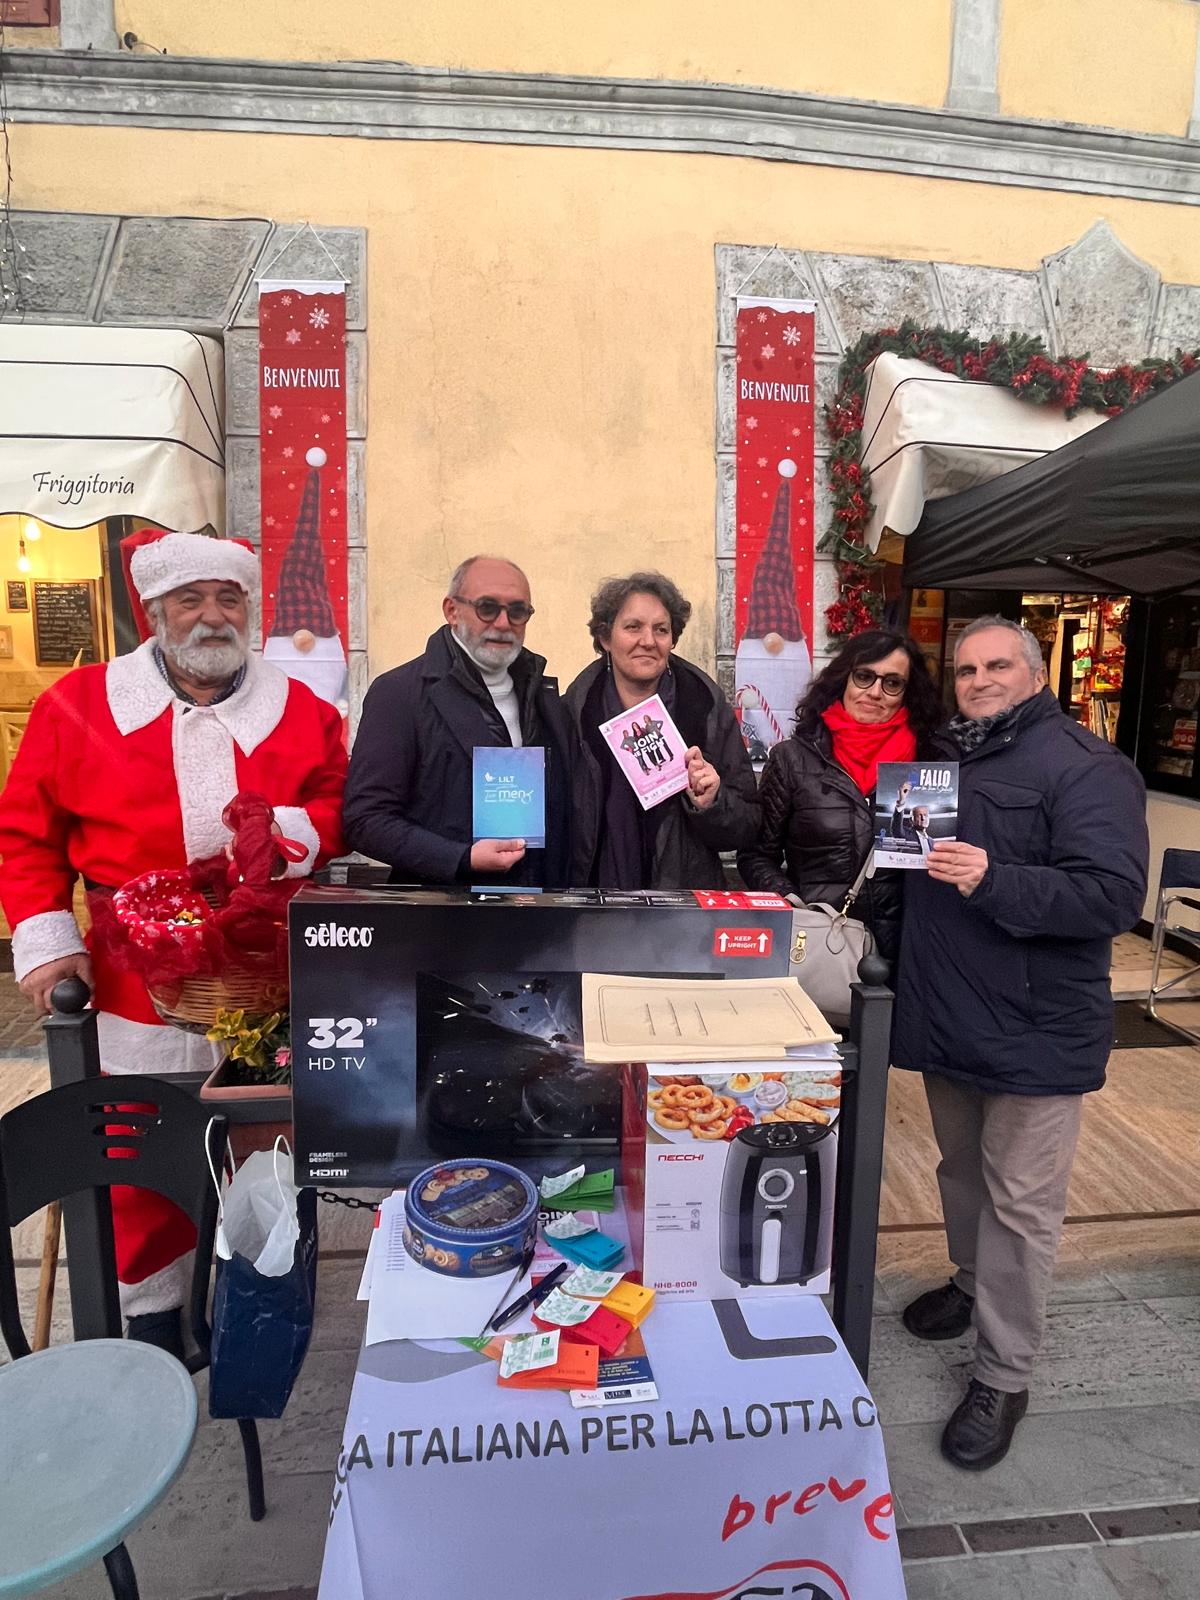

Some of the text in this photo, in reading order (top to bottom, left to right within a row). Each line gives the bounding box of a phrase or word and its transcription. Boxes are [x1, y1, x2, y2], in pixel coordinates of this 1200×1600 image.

[263, 365, 341, 388] BENVENUTI
[741, 378, 810, 403] BENVENUTI
[32, 471, 135, 505] Friggitoria
[633, 731, 659, 751] JOIN
[919, 768, 951, 788] FALLO
[308, 1056, 366, 1071] HD TV
[658, 1154, 704, 1162] NECCHI
[310, 1169, 350, 1177] HDMI
[386, 1419, 570, 1468] ITALIANA
[581, 1413, 655, 1454] PER
[666, 1408, 714, 1446] LA
[723, 1398, 842, 1440] LOTTA
